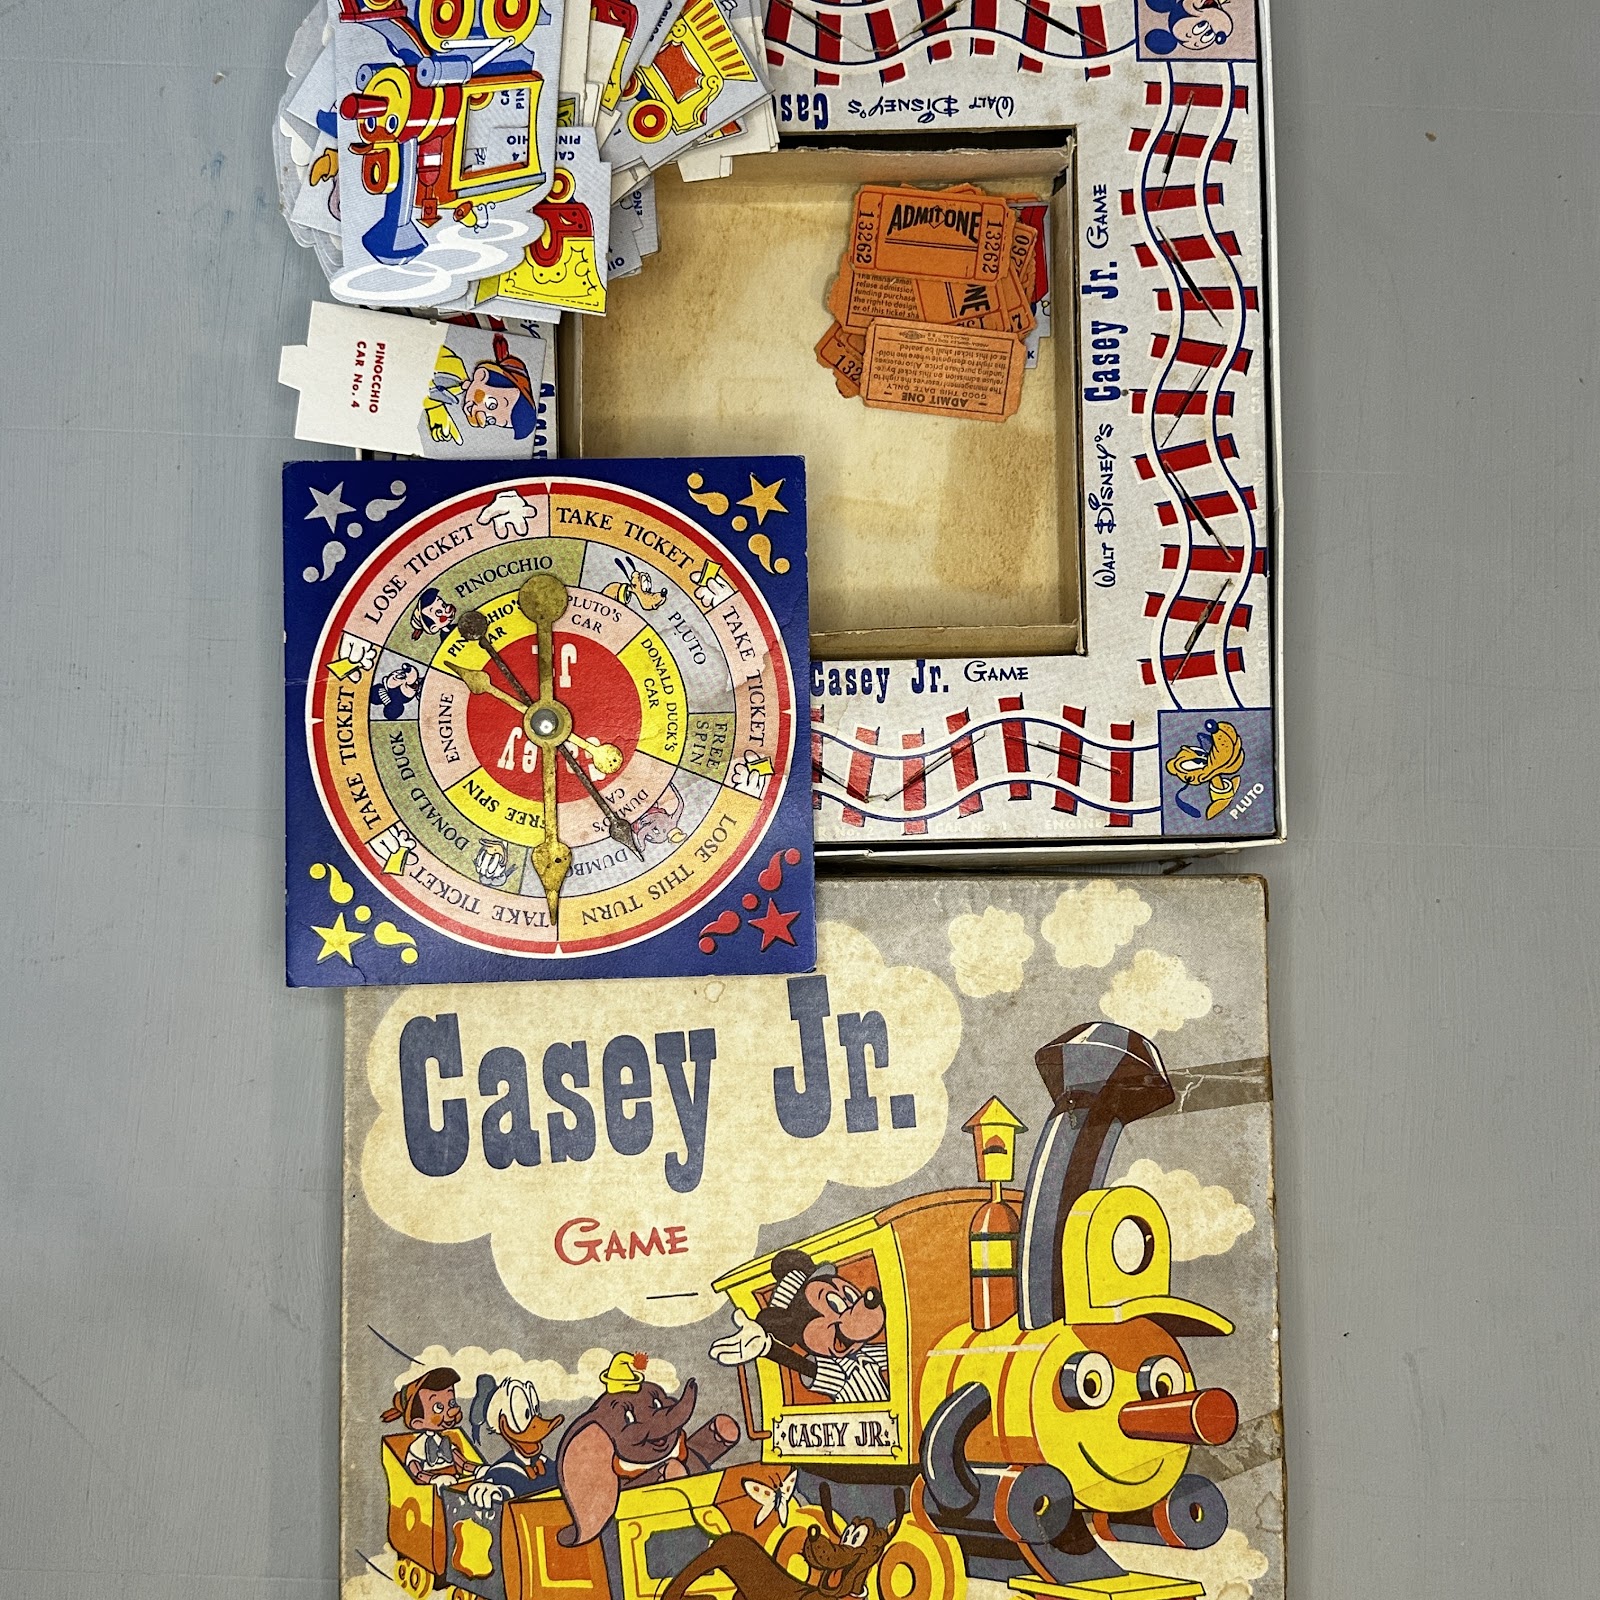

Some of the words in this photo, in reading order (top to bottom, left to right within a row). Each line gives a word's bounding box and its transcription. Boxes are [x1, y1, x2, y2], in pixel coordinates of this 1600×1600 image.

[772, 92, 828, 130] Cas
[969, 96, 1015, 119] WALT
[1242, 117, 1254, 173] ENGINE
[887, 203, 945, 236] ADMIT
[944, 209, 982, 244] ONE
[1086, 183, 1110, 250] GAME
[857, 210, 874, 264] 13262
[982, 220, 1001, 275] 13262
[1082, 261, 1119, 300] Jr.
[1247, 254, 1259, 281] CAR
[855, 288, 881, 297] funding
[884, 292, 915, 301] purchase
[856, 280, 877, 288] refuse
[866, 298, 883, 306] right
[959, 284, 991, 316] NE
[355, 340, 367, 367] CAR
[873, 356, 904, 365] reserves
[876, 349, 895, 358] hold-
[897, 343, 922, 353] sealed.
[908, 353, 930, 362] where
[931, 354, 965, 365] designate
[936, 347, 952, 355] shall
[953, 349, 973, 358] ticket
[1084, 320, 1129, 402] Casey
[369, 341, 386, 414] PINOCCHIO
[834, 355, 862, 381] 132
[881, 373, 899, 382] right
[897, 368, 916, 376] ticket
[905, 360, 921, 369] Also
[918, 370, 931, 378] this
[922, 361, 943, 371] price.
[944, 364, 975, 374] purchase
[945, 373, 979, 383] admission
[976, 359, 992, 369] right
[977, 368, 1004, 378] funding
[351, 373, 363, 396] No.
[886, 382, 909, 390] ONLY
[913, 377, 942, 386] reserves
[913, 386, 935, 394] DATE
[939, 388, 957, 396] THIS
[943, 380, 988, 392] management
[961, 391, 986, 399] GOOD
[981, 377, 1003, 385] refuse
[350, 400, 360, 409] 4
[901, 391, 925, 403] ONE
[929, 394, 968, 408] ADMIT
[1088, 423, 1117, 535] DISNEY'S
[556, 506, 614, 531] TAKE
[624, 521, 694, 570] TICKET
[364, 574, 407, 625] LOSE
[403, 523, 475, 576] TICKET
[454, 555, 553, 598] PINOCCHIO
[1094, 545, 1117, 587] WALT
[571, 613, 602, 634] CAR
[668, 611, 707, 666] PLUTO
[722, 605, 756, 662] TAKE
[746, 669, 767, 747] TICKET
[810, 661, 890, 704] Casey
[911, 659, 949, 694] Jr.
[964, 660, 1029, 682] GAME
[640, 637, 675, 695] DONALD
[664, 702, 678, 752] DUCK'S
[644, 677, 660, 709] CAR
[337, 686, 357, 765] TICKET
[438, 693, 460, 763] ENGINE
[389, 730, 416, 782] DUCK
[690, 720, 709, 766] SPIN
[706, 722, 728, 770] FREE
[346, 772, 382, 830] TAKE
[462, 779, 500, 813] SPIN
[1229, 782, 1265, 820] PLUTO
[410, 787, 470, 851] DONALD
[592, 789, 649, 833] DUMO'S
[694, 813, 737, 863] LOSE
[409, 866, 481, 915] TICKET
[648, 865, 694, 900] THIS
[491, 904, 550, 928] TAKE
[581, 894, 643, 925] TURN
[399, 1012, 717, 1193] Casey
[773, 974, 917, 1139] Jr.
[554, 1216, 689, 1266] GAME
[788, 1422, 850, 1448] CASEY
[855, 1420, 891, 1447] JR.
